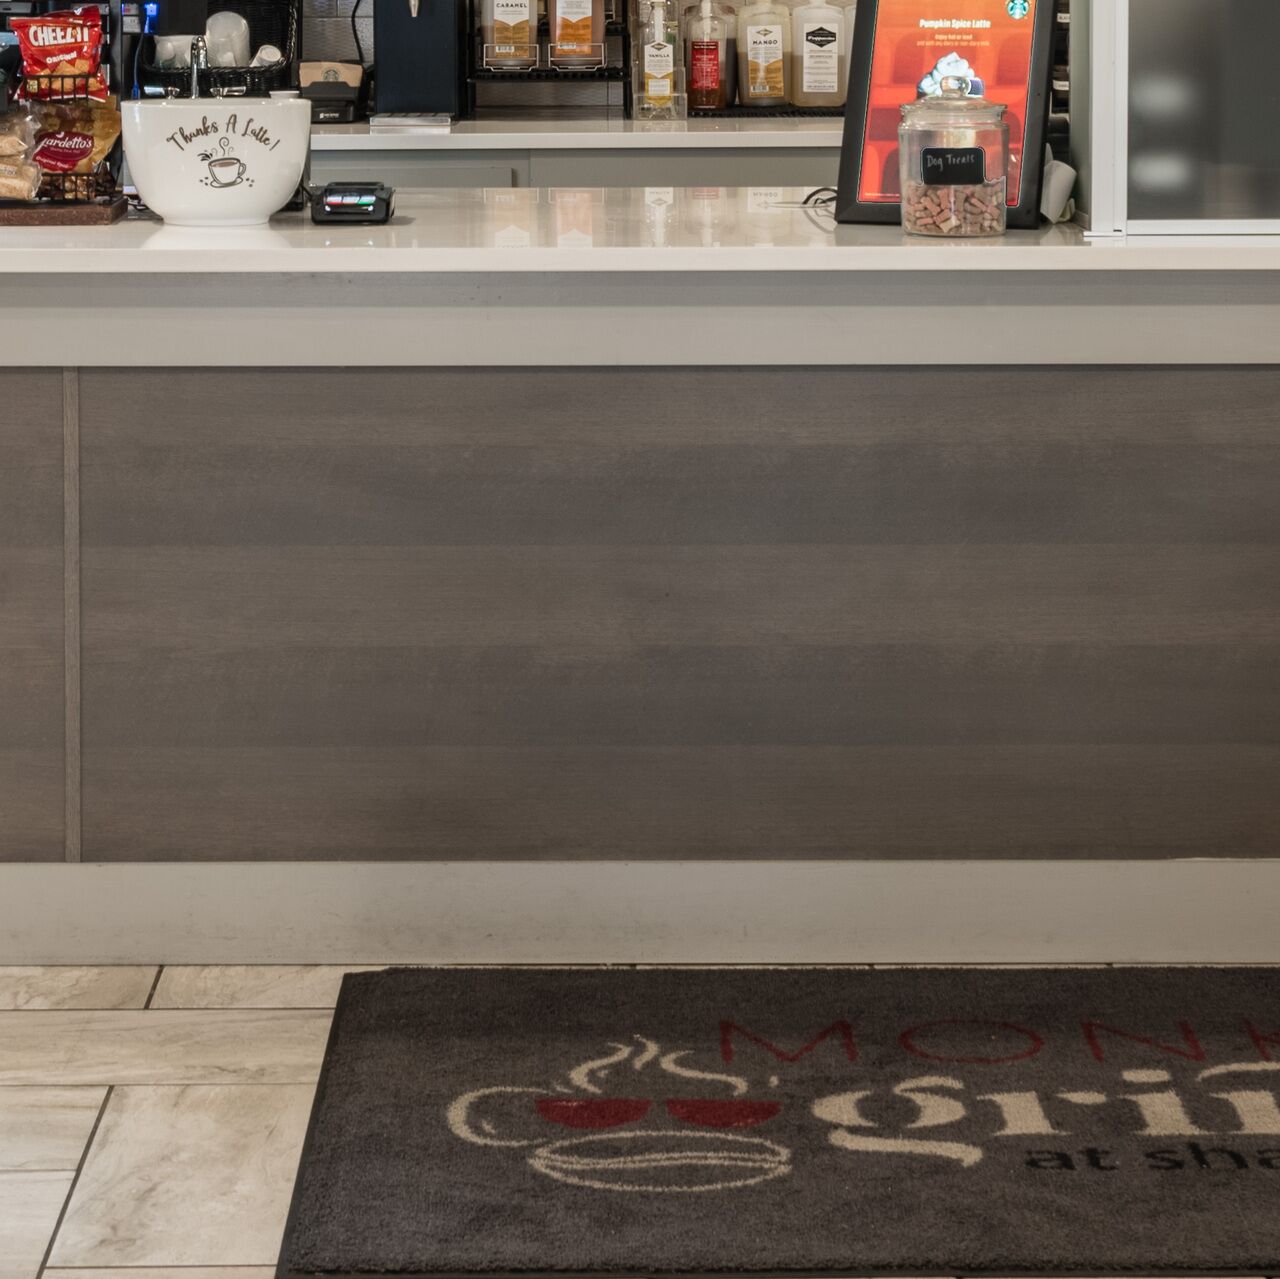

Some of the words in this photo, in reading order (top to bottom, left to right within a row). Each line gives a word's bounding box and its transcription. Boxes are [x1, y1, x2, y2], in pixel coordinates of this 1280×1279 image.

[919, 19, 950, 29] Pumpkin
[951, 19, 971, 29] Spice
[972, 19, 990, 28] Latte
[166, 115, 219, 151] Thanks
[226, 114, 237, 134] A
[927, 155, 943, 170] Dog
[1024, 1143, 1119, 1172] at
